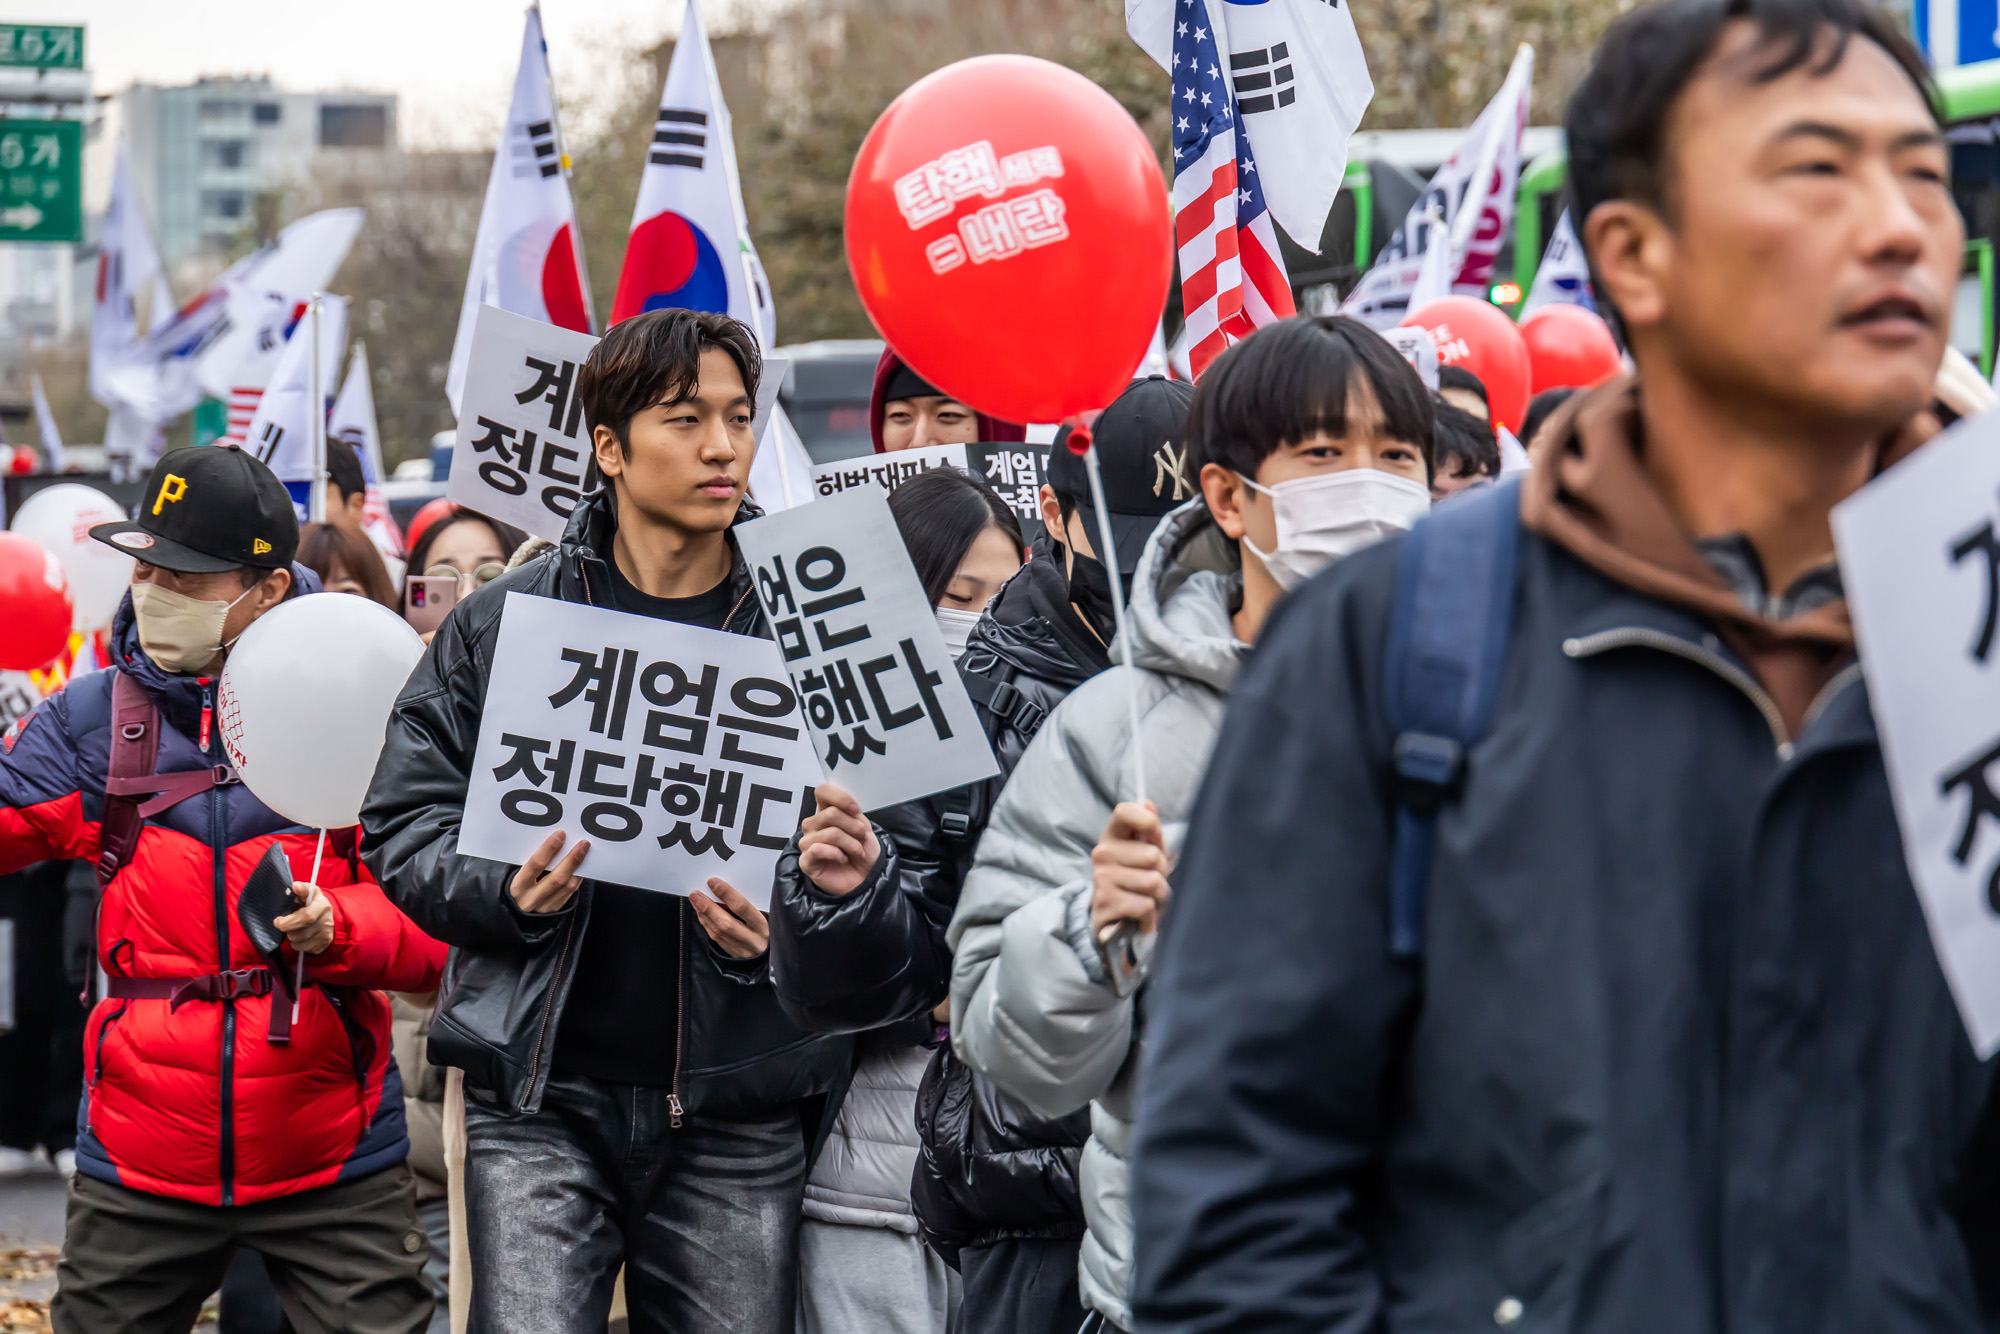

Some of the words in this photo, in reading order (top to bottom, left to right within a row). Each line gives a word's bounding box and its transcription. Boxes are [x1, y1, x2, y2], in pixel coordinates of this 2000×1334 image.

[894, 140, 1004, 231] 탄핵
[1000, 145, 1065, 189] 세력
[152, 473, 188, 515] P
[985, 450, 1039, 485] 계엄
[1153, 440, 1196, 500] NY
[750, 546, 872, 662] 엄은
[548, 646, 800, 771] 계엄은
[789, 637, 954, 771] 했다
[491, 732, 816, 862] 정당했다
